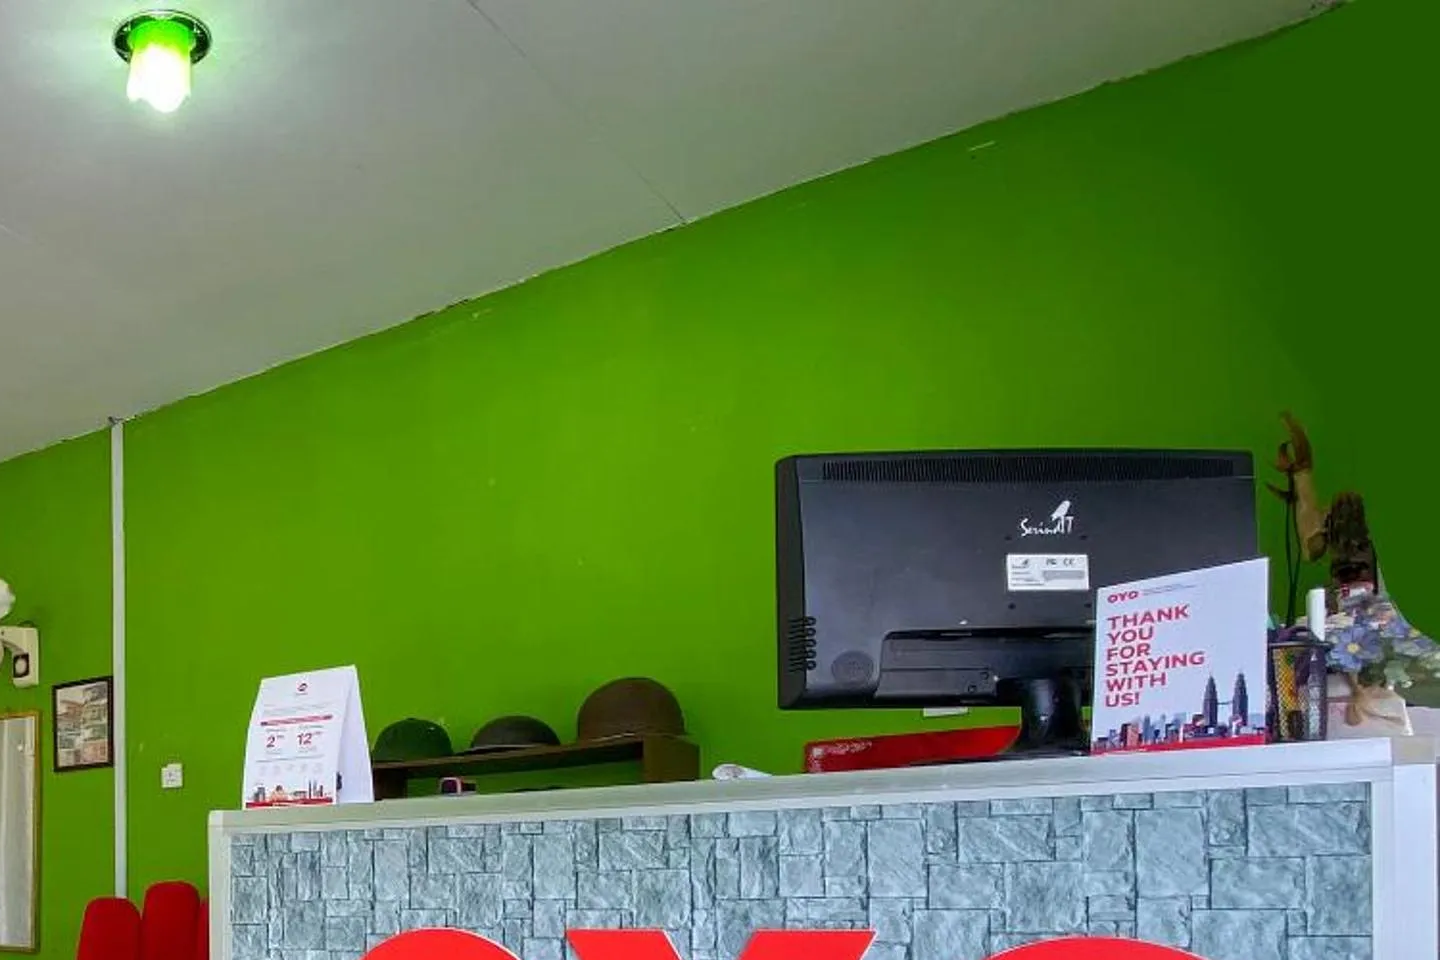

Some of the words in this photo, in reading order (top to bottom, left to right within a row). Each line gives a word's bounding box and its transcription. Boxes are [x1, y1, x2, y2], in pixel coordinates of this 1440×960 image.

[1106, 590, 1139, 604] OYO
[1107, 604, 1190, 629] THANK
[1106, 626, 1154, 646] YOU
[1106, 643, 1151, 662] FOR
[1105, 651, 1205, 677] STAYING
[1105, 672, 1167, 693] WITH
[1105, 692, 1140, 708] US!
